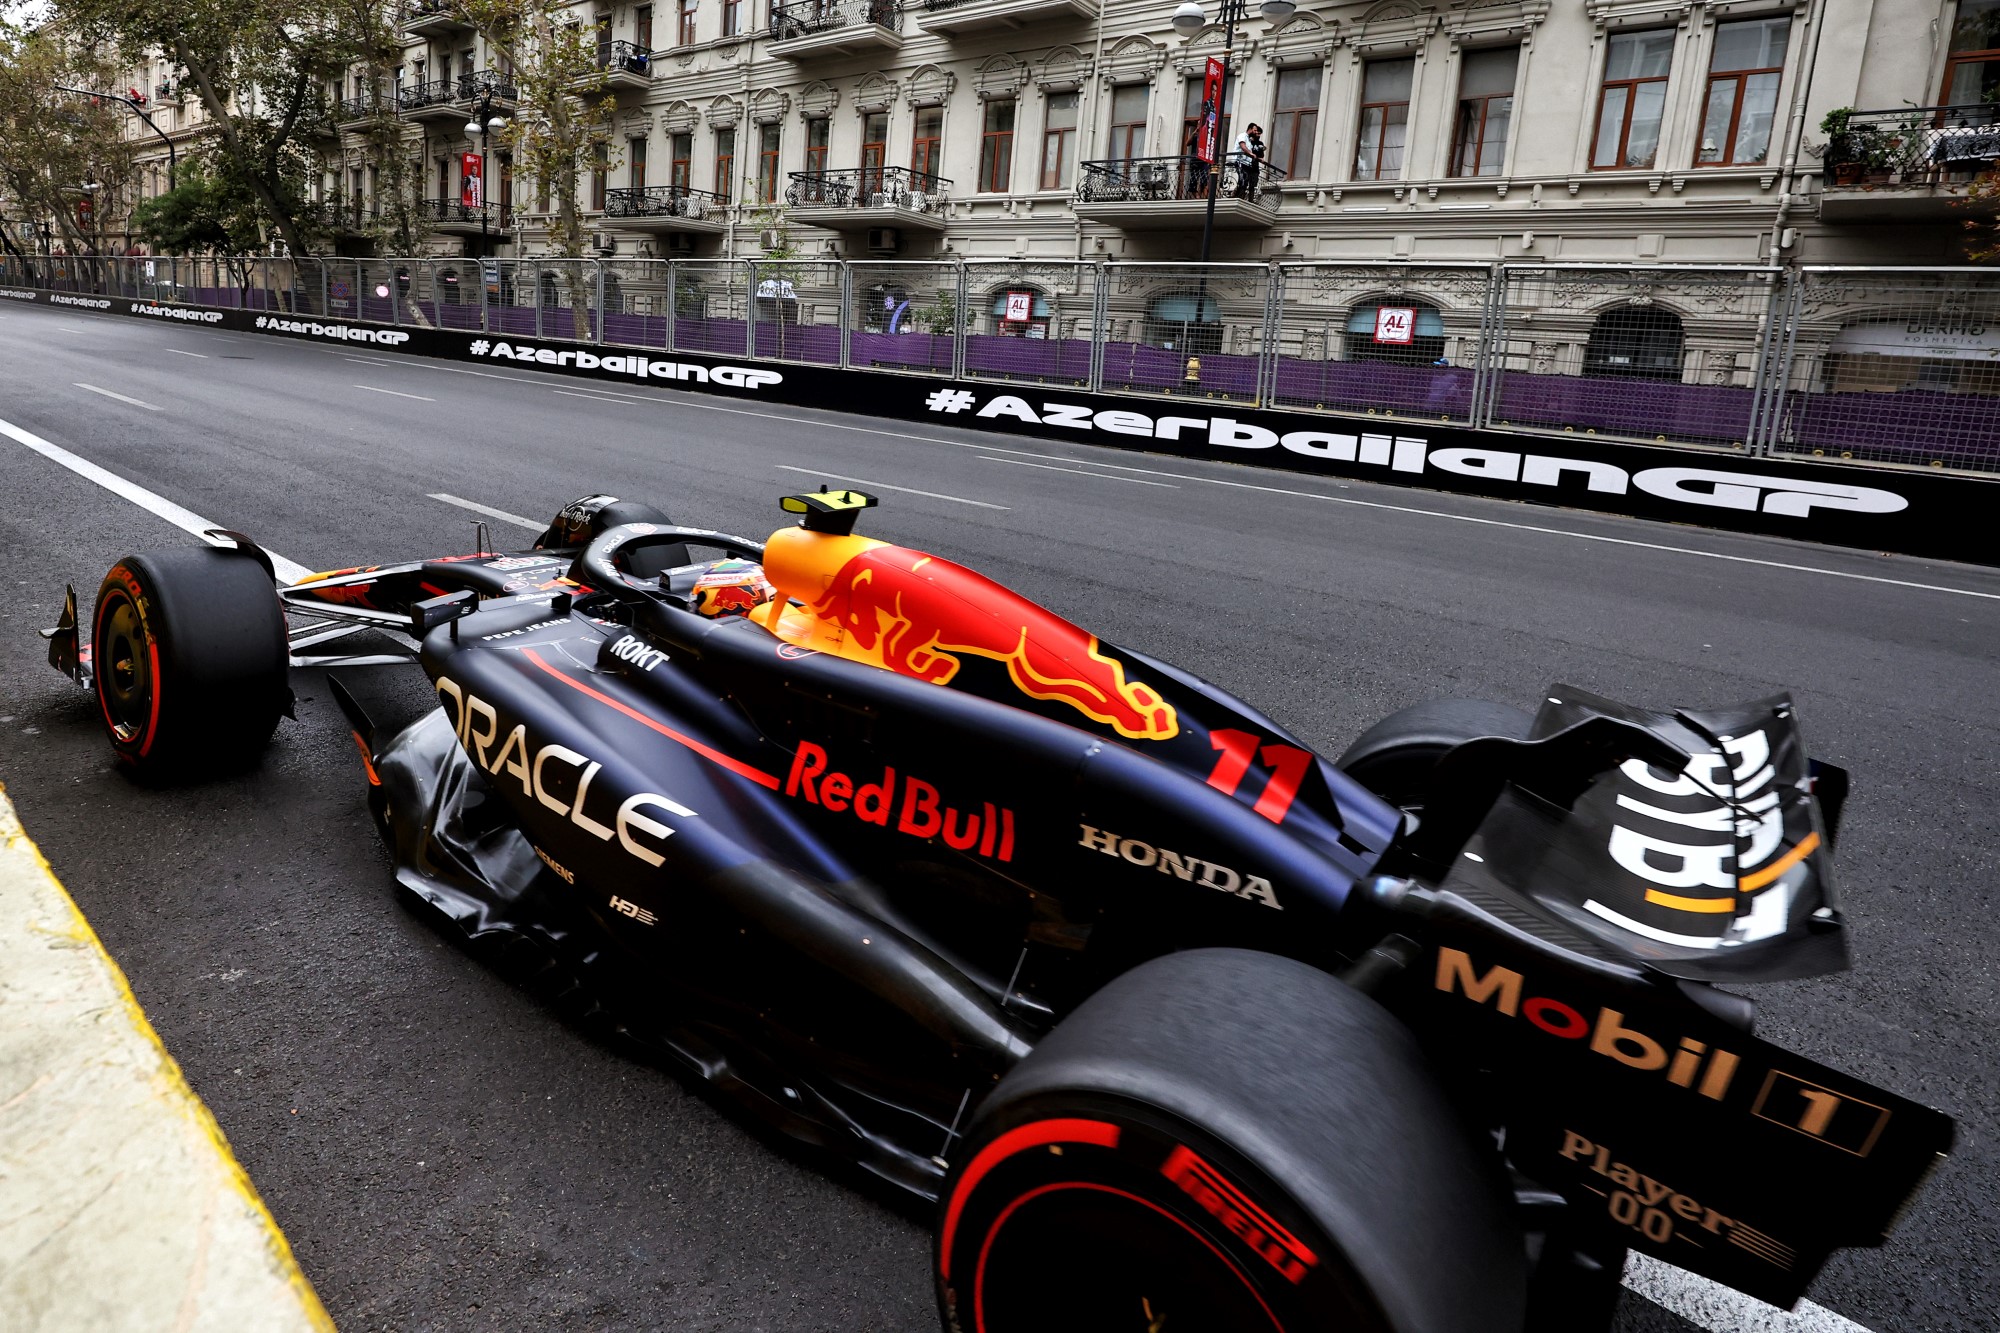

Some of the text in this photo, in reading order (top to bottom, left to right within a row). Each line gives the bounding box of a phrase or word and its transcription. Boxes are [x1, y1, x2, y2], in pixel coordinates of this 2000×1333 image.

[0, 289, 37, 300] zerbaijanGP
[50, 294, 111, 309] #AzerbaijanGP
[131, 303, 223, 323] #AzerbaijanGP
[1012, 299, 1025, 310] AL
[256, 316, 410, 346] #AzerbaijanGP
[1384, 315, 1405, 329] AL
[470, 339, 783, 389] #AzerbaijanGP
[924, 388, 1909, 518] #AzerbaijanGP
[575, 511, 591, 525] Rock
[482, 618, 572, 641] PEPE JEANS
[609, 634, 671, 672] ROKT
[436, 676, 699, 868] ORACLE
[1206, 728, 1314, 825] 11
[785, 740, 1015, 862] Red Bull
[1078, 823, 1284, 911] HONDA
[1434, 945, 1842, 1138] Mobil 1
[1558, 1128, 1738, 1236] Player
